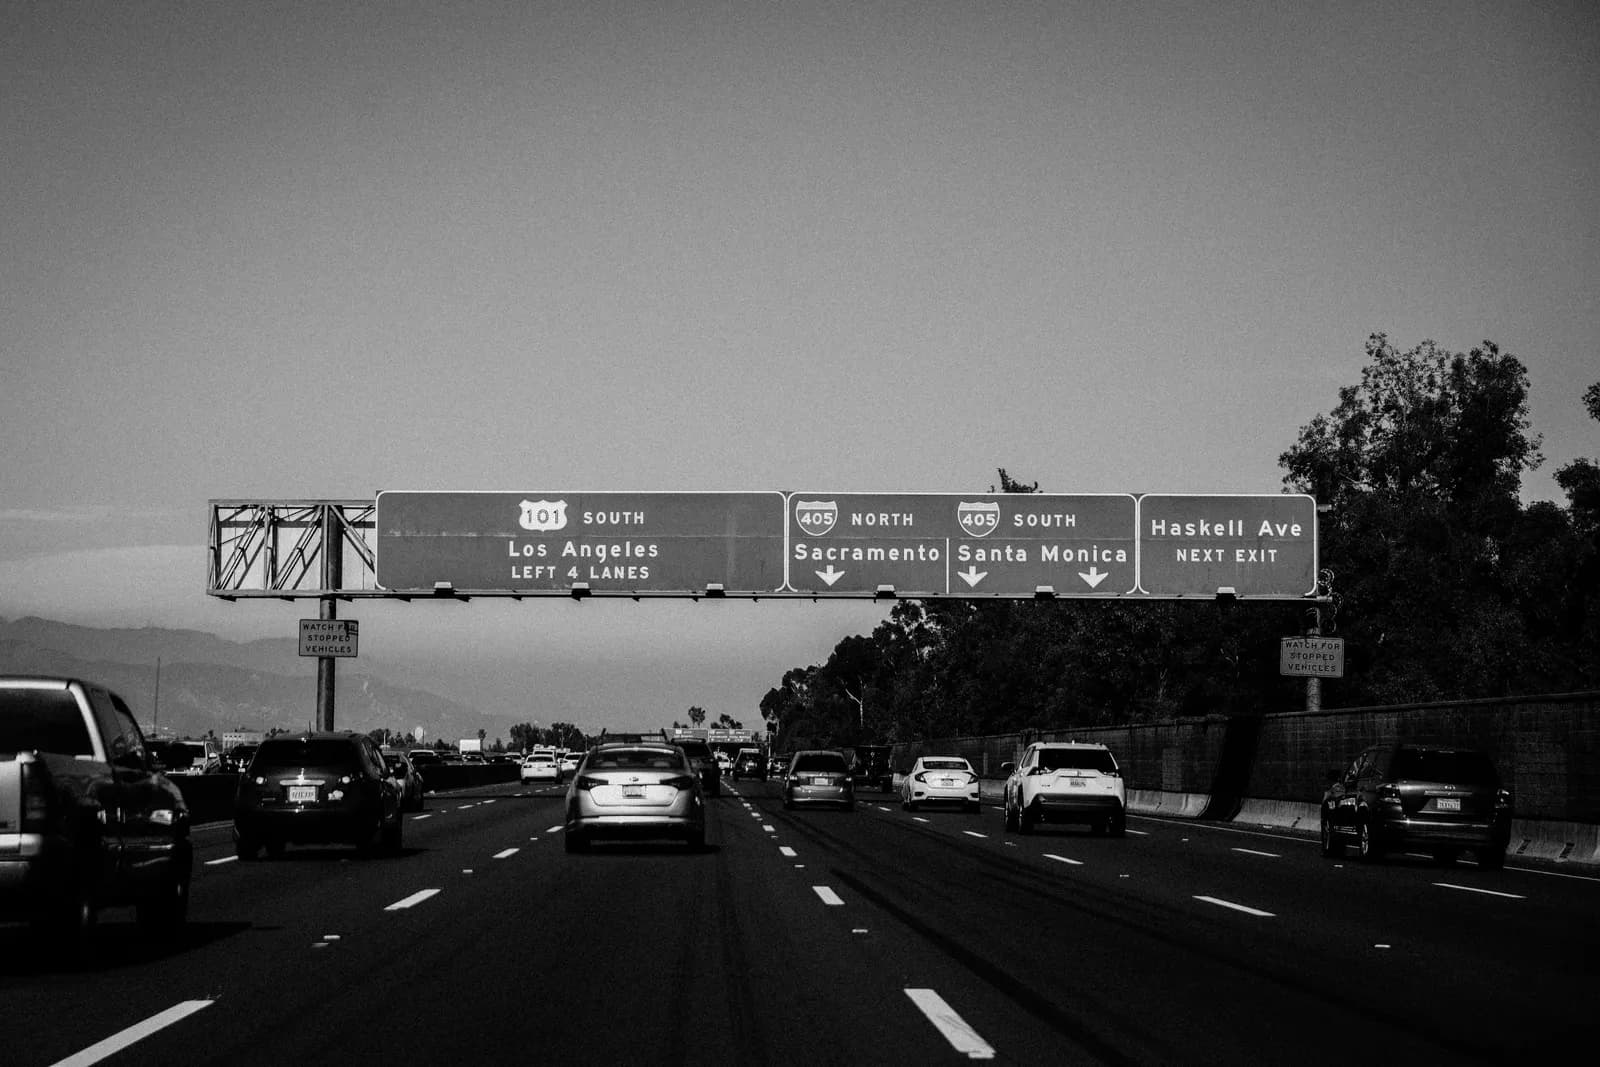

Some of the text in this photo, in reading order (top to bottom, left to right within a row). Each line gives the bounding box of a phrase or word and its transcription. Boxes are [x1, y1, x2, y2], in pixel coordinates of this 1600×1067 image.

[526, 509, 645, 525] 101 SOUTH
[801, 512, 914, 526] 405 NORTH
[961, 513, 1076, 527] 405 SOUTH
[1151, 519, 1302, 537] Haskell Ave
[508, 540, 659, 564] Los Angeles
[794, 543, 940, 561] Sacramento
[958, 544, 1127, 562] Santa Monica
[1176, 548, 1277, 563] NEXT EXIT
[511, 566, 649, 579] LEFT 4 LANES
[303, 623, 334, 631] WATCH
[307, 634, 351, 642] STOPPED
[305, 645, 352, 653] VEHICLES
[1285, 641, 1340, 650] WATCH FOR
[1289, 652, 1335, 661] STOPPED
[1287, 663, 1336, 672] VEHICLES
